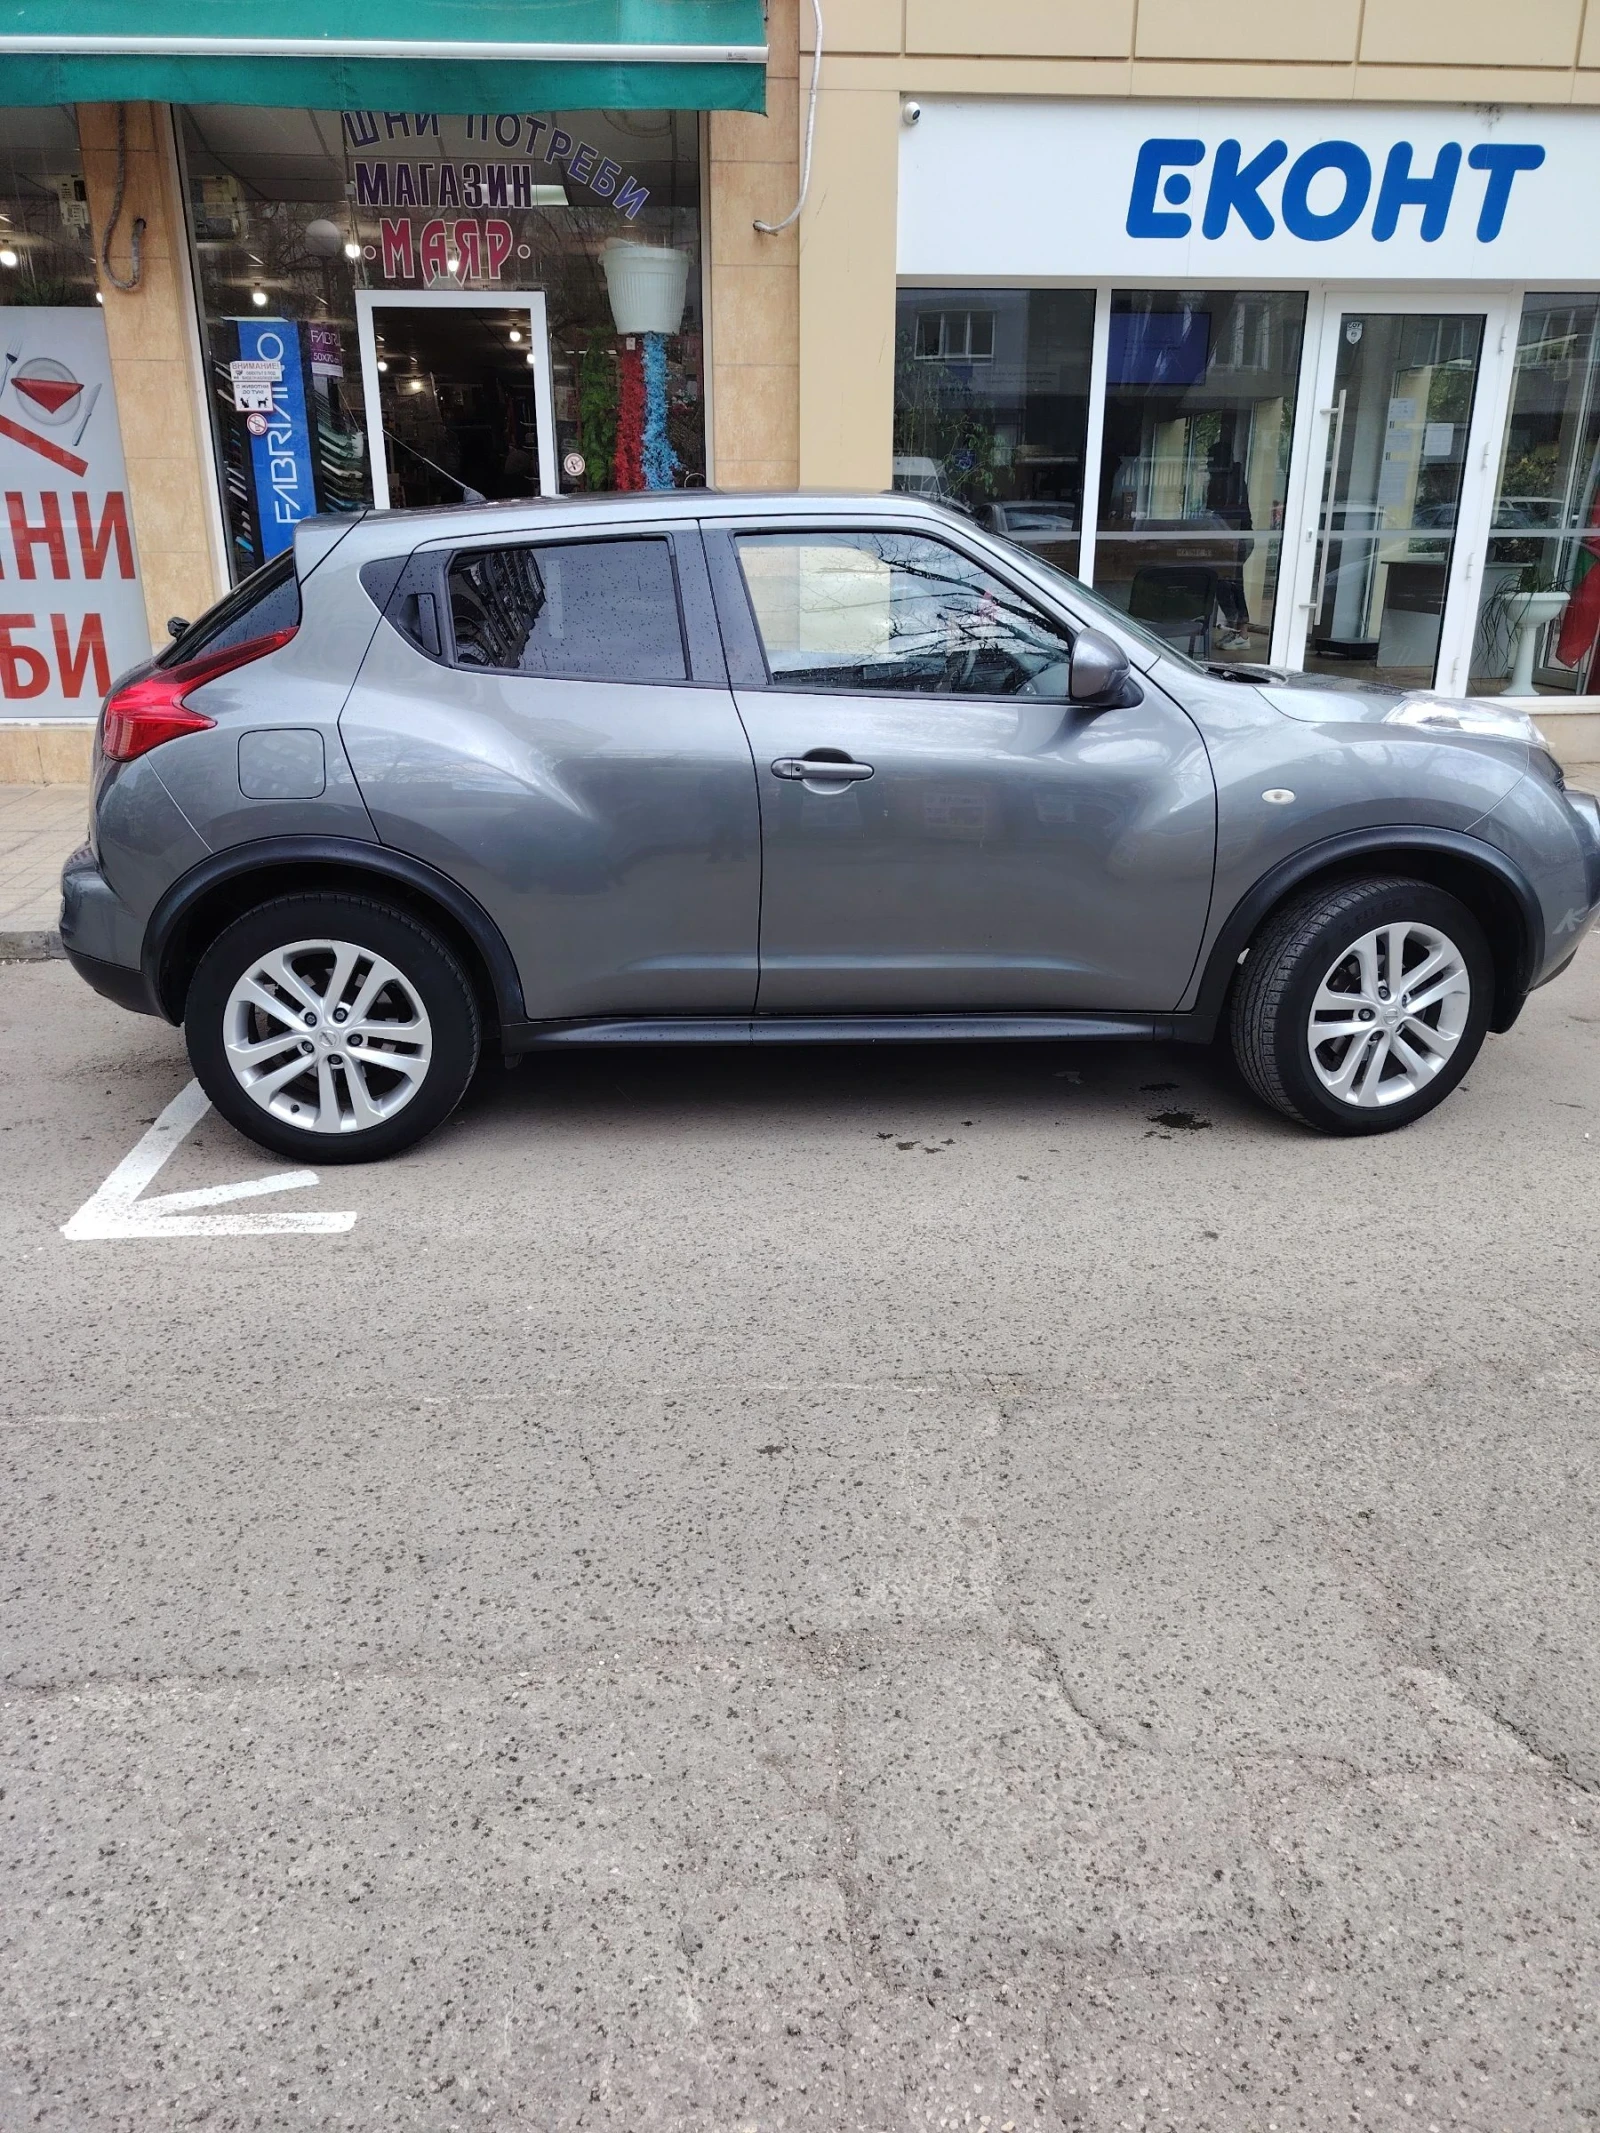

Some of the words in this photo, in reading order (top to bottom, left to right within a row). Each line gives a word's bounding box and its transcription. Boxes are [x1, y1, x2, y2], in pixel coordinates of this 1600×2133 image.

[353, 161, 533, 209] МАГАЗИН
[1125, 138, 1547, 243] ЕКОНТ
[379, 217, 513, 288] МАЯР
